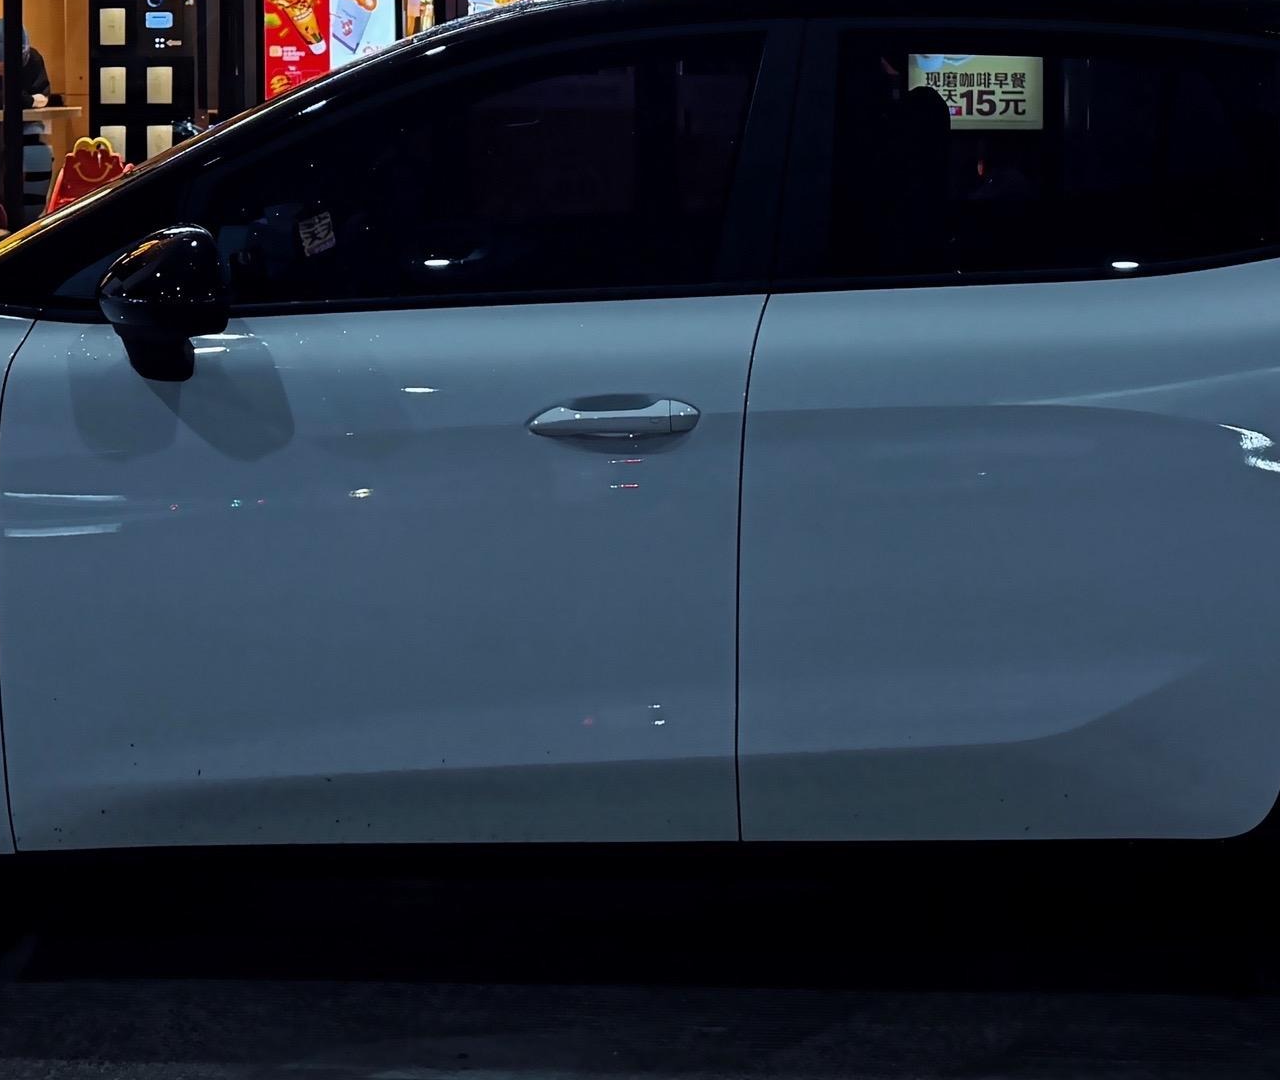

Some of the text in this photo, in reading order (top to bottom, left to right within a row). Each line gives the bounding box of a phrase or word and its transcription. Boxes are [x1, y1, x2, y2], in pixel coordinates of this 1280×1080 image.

[926, 72, 1026, 89] 现磨咖啡早餐
